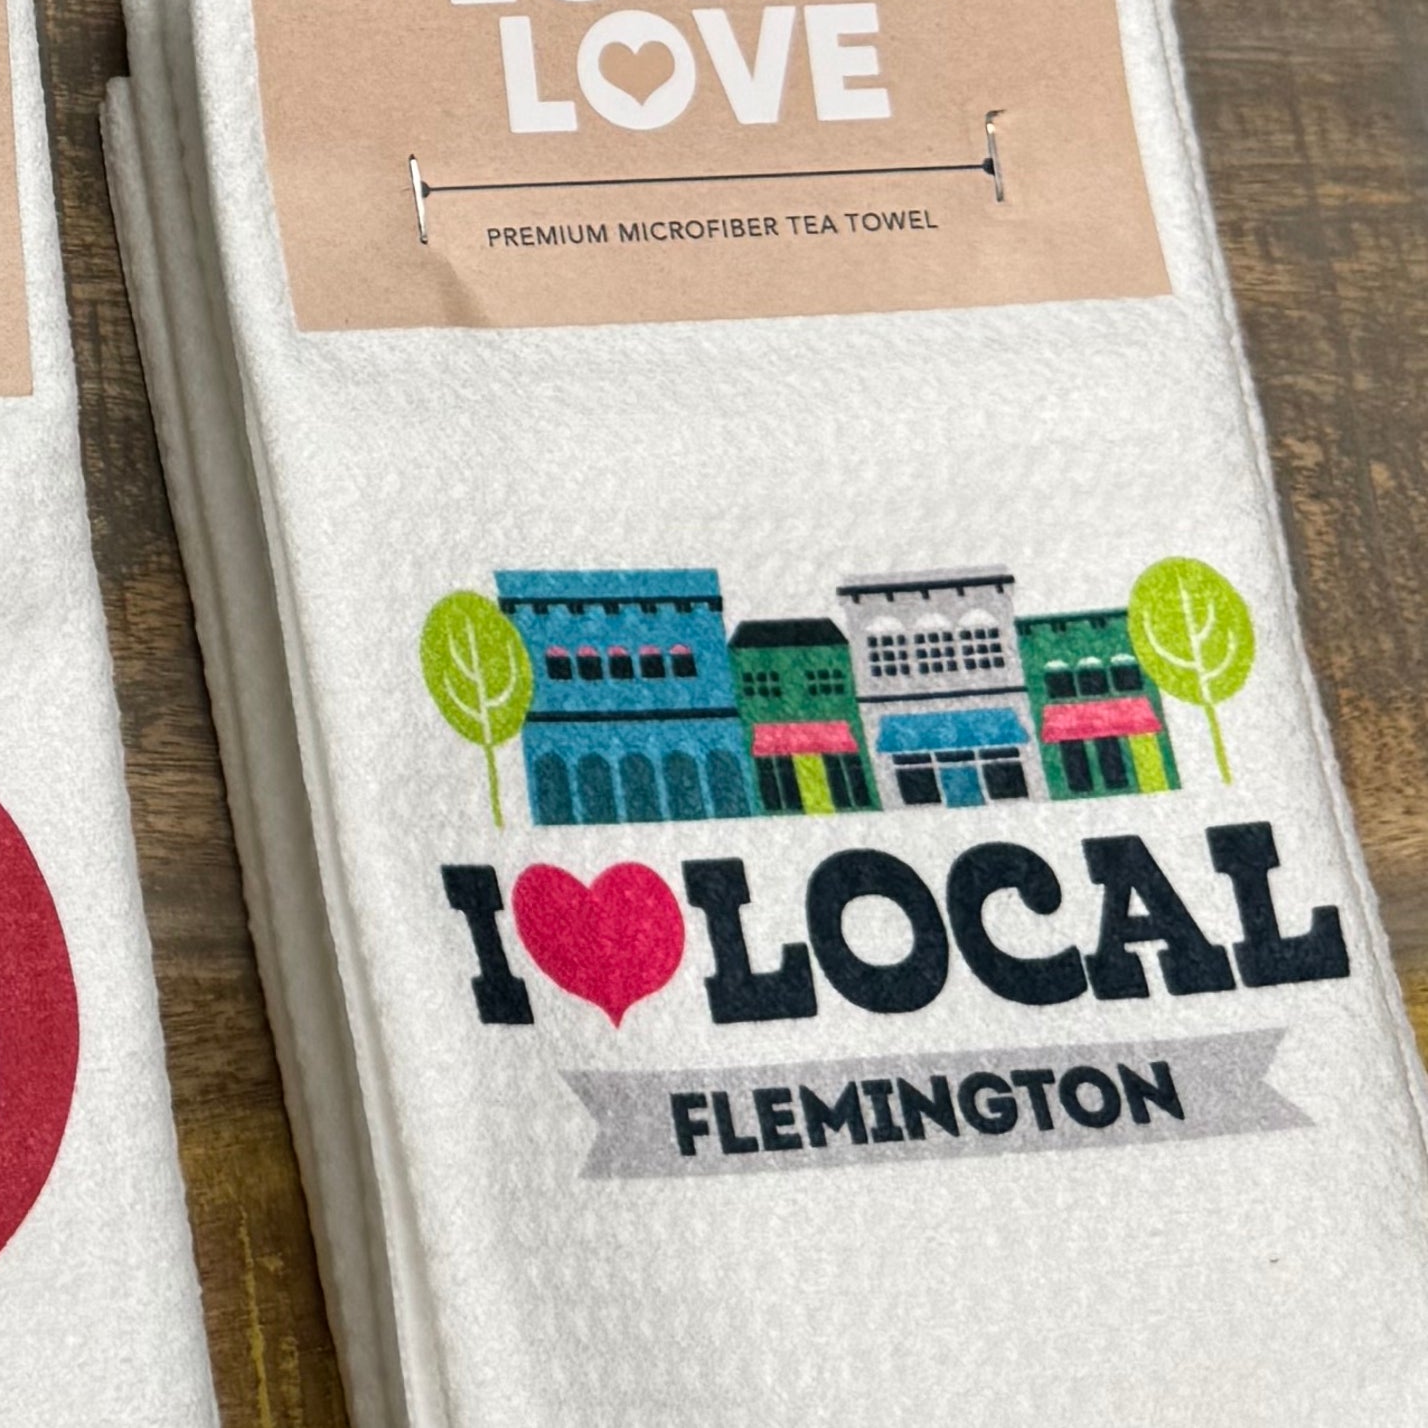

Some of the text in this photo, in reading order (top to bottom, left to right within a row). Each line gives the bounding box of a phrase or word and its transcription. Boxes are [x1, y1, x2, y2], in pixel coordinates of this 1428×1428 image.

[497, 2, 893, 134] LOVE
[486, 208, 939, 249] PREMIUM MICROFIBER TEA TOWEL
[440, 819, 1352, 1027] I LOCAL
[668, 1058, 1187, 1160] FLEMINGTON
